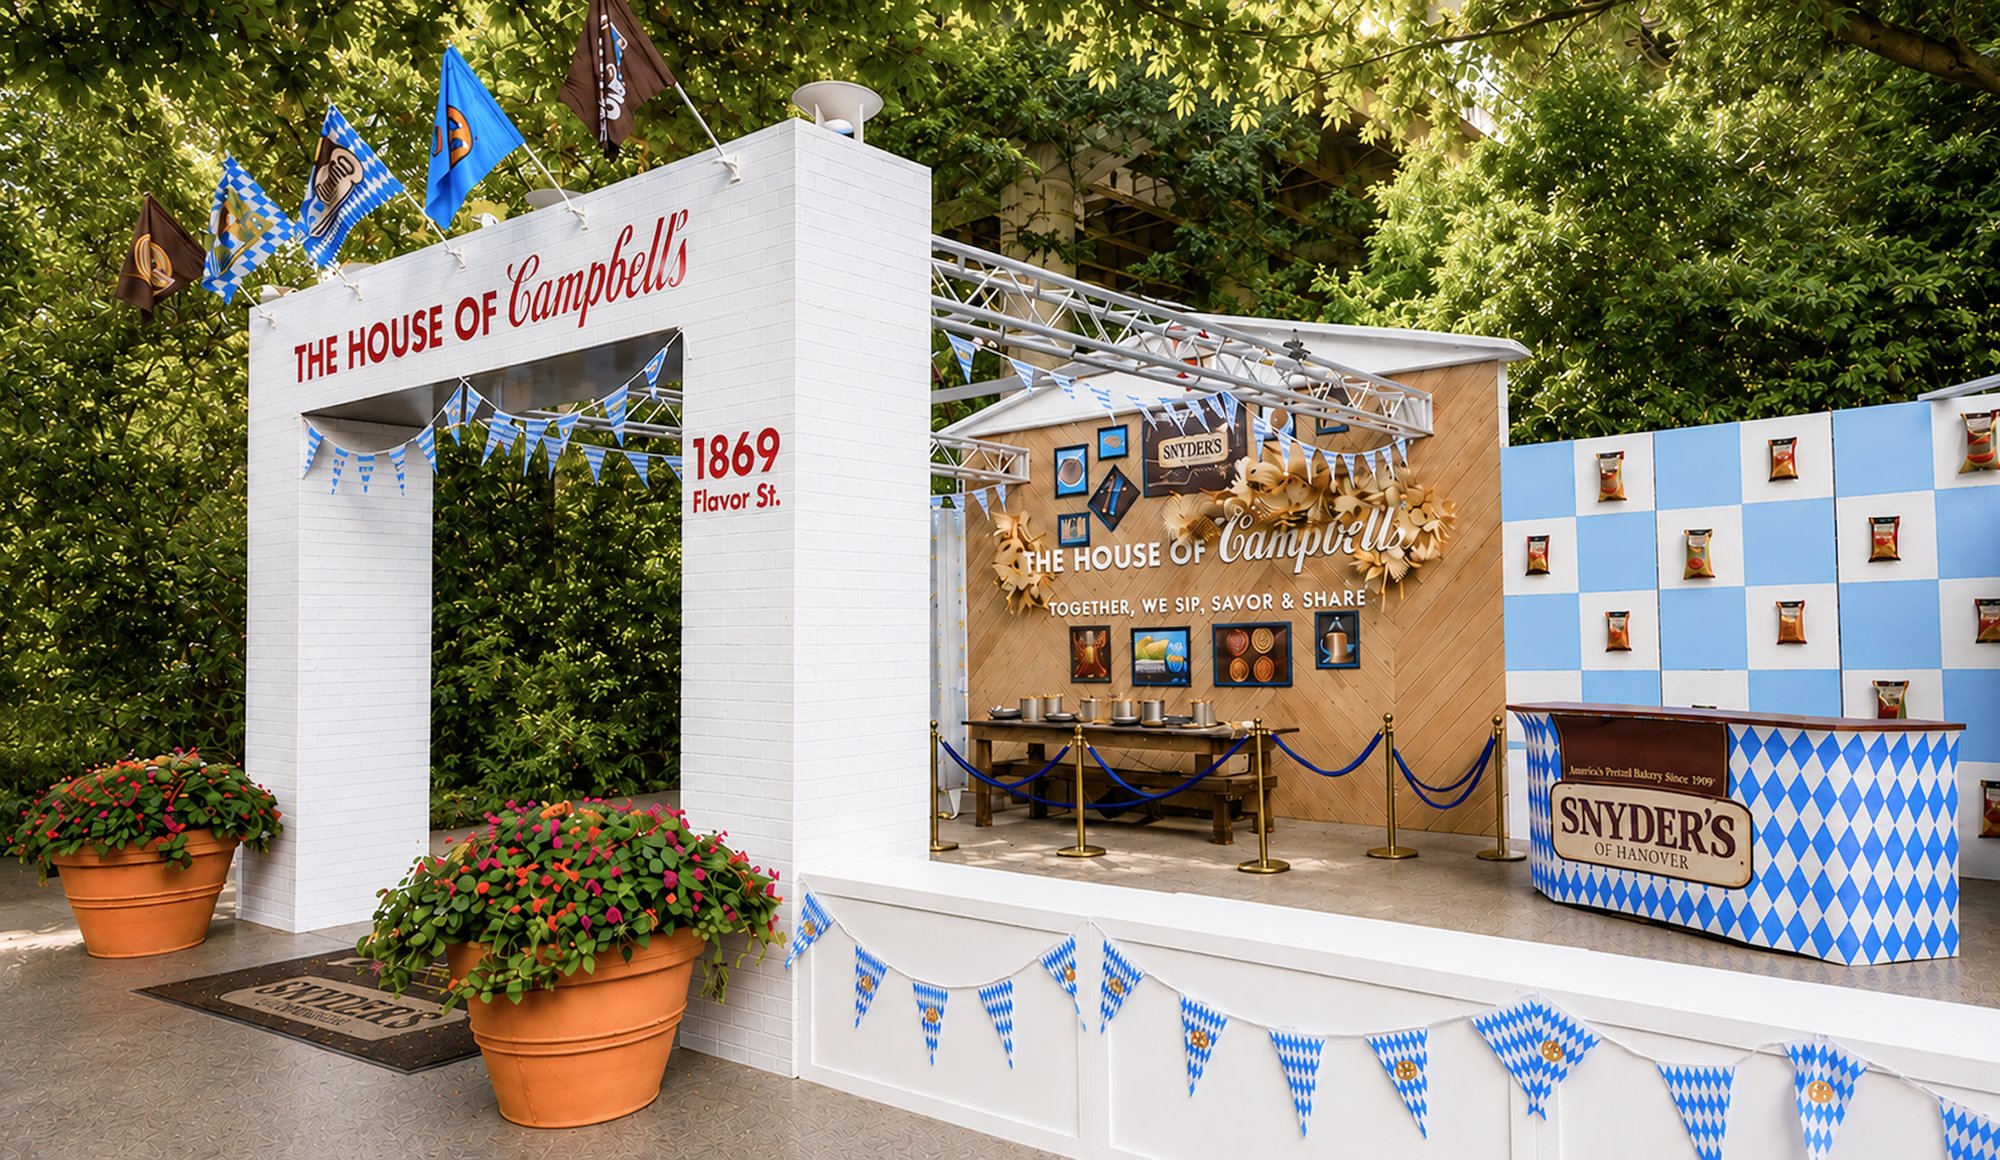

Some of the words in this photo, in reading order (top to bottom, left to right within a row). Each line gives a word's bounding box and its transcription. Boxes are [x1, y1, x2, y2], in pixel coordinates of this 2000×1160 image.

[294, 335, 337, 383] THE
[348, 304, 443, 370] HOUSE
[455, 290, 497, 341] OF
[507, 208, 689, 328] Campbell's
[693, 427, 780, 480] 1869
[1163, 438, 1222, 459] SNYDER'S
[693, 489, 750, 513] Flavor
[756, 482, 781, 508] St.
[1023, 549, 1064, 573] THE
[1074, 542, 1161, 572] HOUSE
[1169, 539, 1206, 565] OF
[1048, 599, 1135, 617] TOGETHER,
[1142, 598, 1167, 613] WE
[1175, 597, 1205, 615] SIP,
[1211, 594, 1273, 612] SAVOR
[1281, 592, 1294, 609] &
[1303, 589, 1366, 608] SHARE
[1633, 768, 1663, 783] Bakery
[1665, 772, 1689, 785] Since
[1560, 796, 1736, 858] SNYDER'S
[1594, 841, 1612, 857] OF
[1616, 845, 1689, 870] HANOVER
